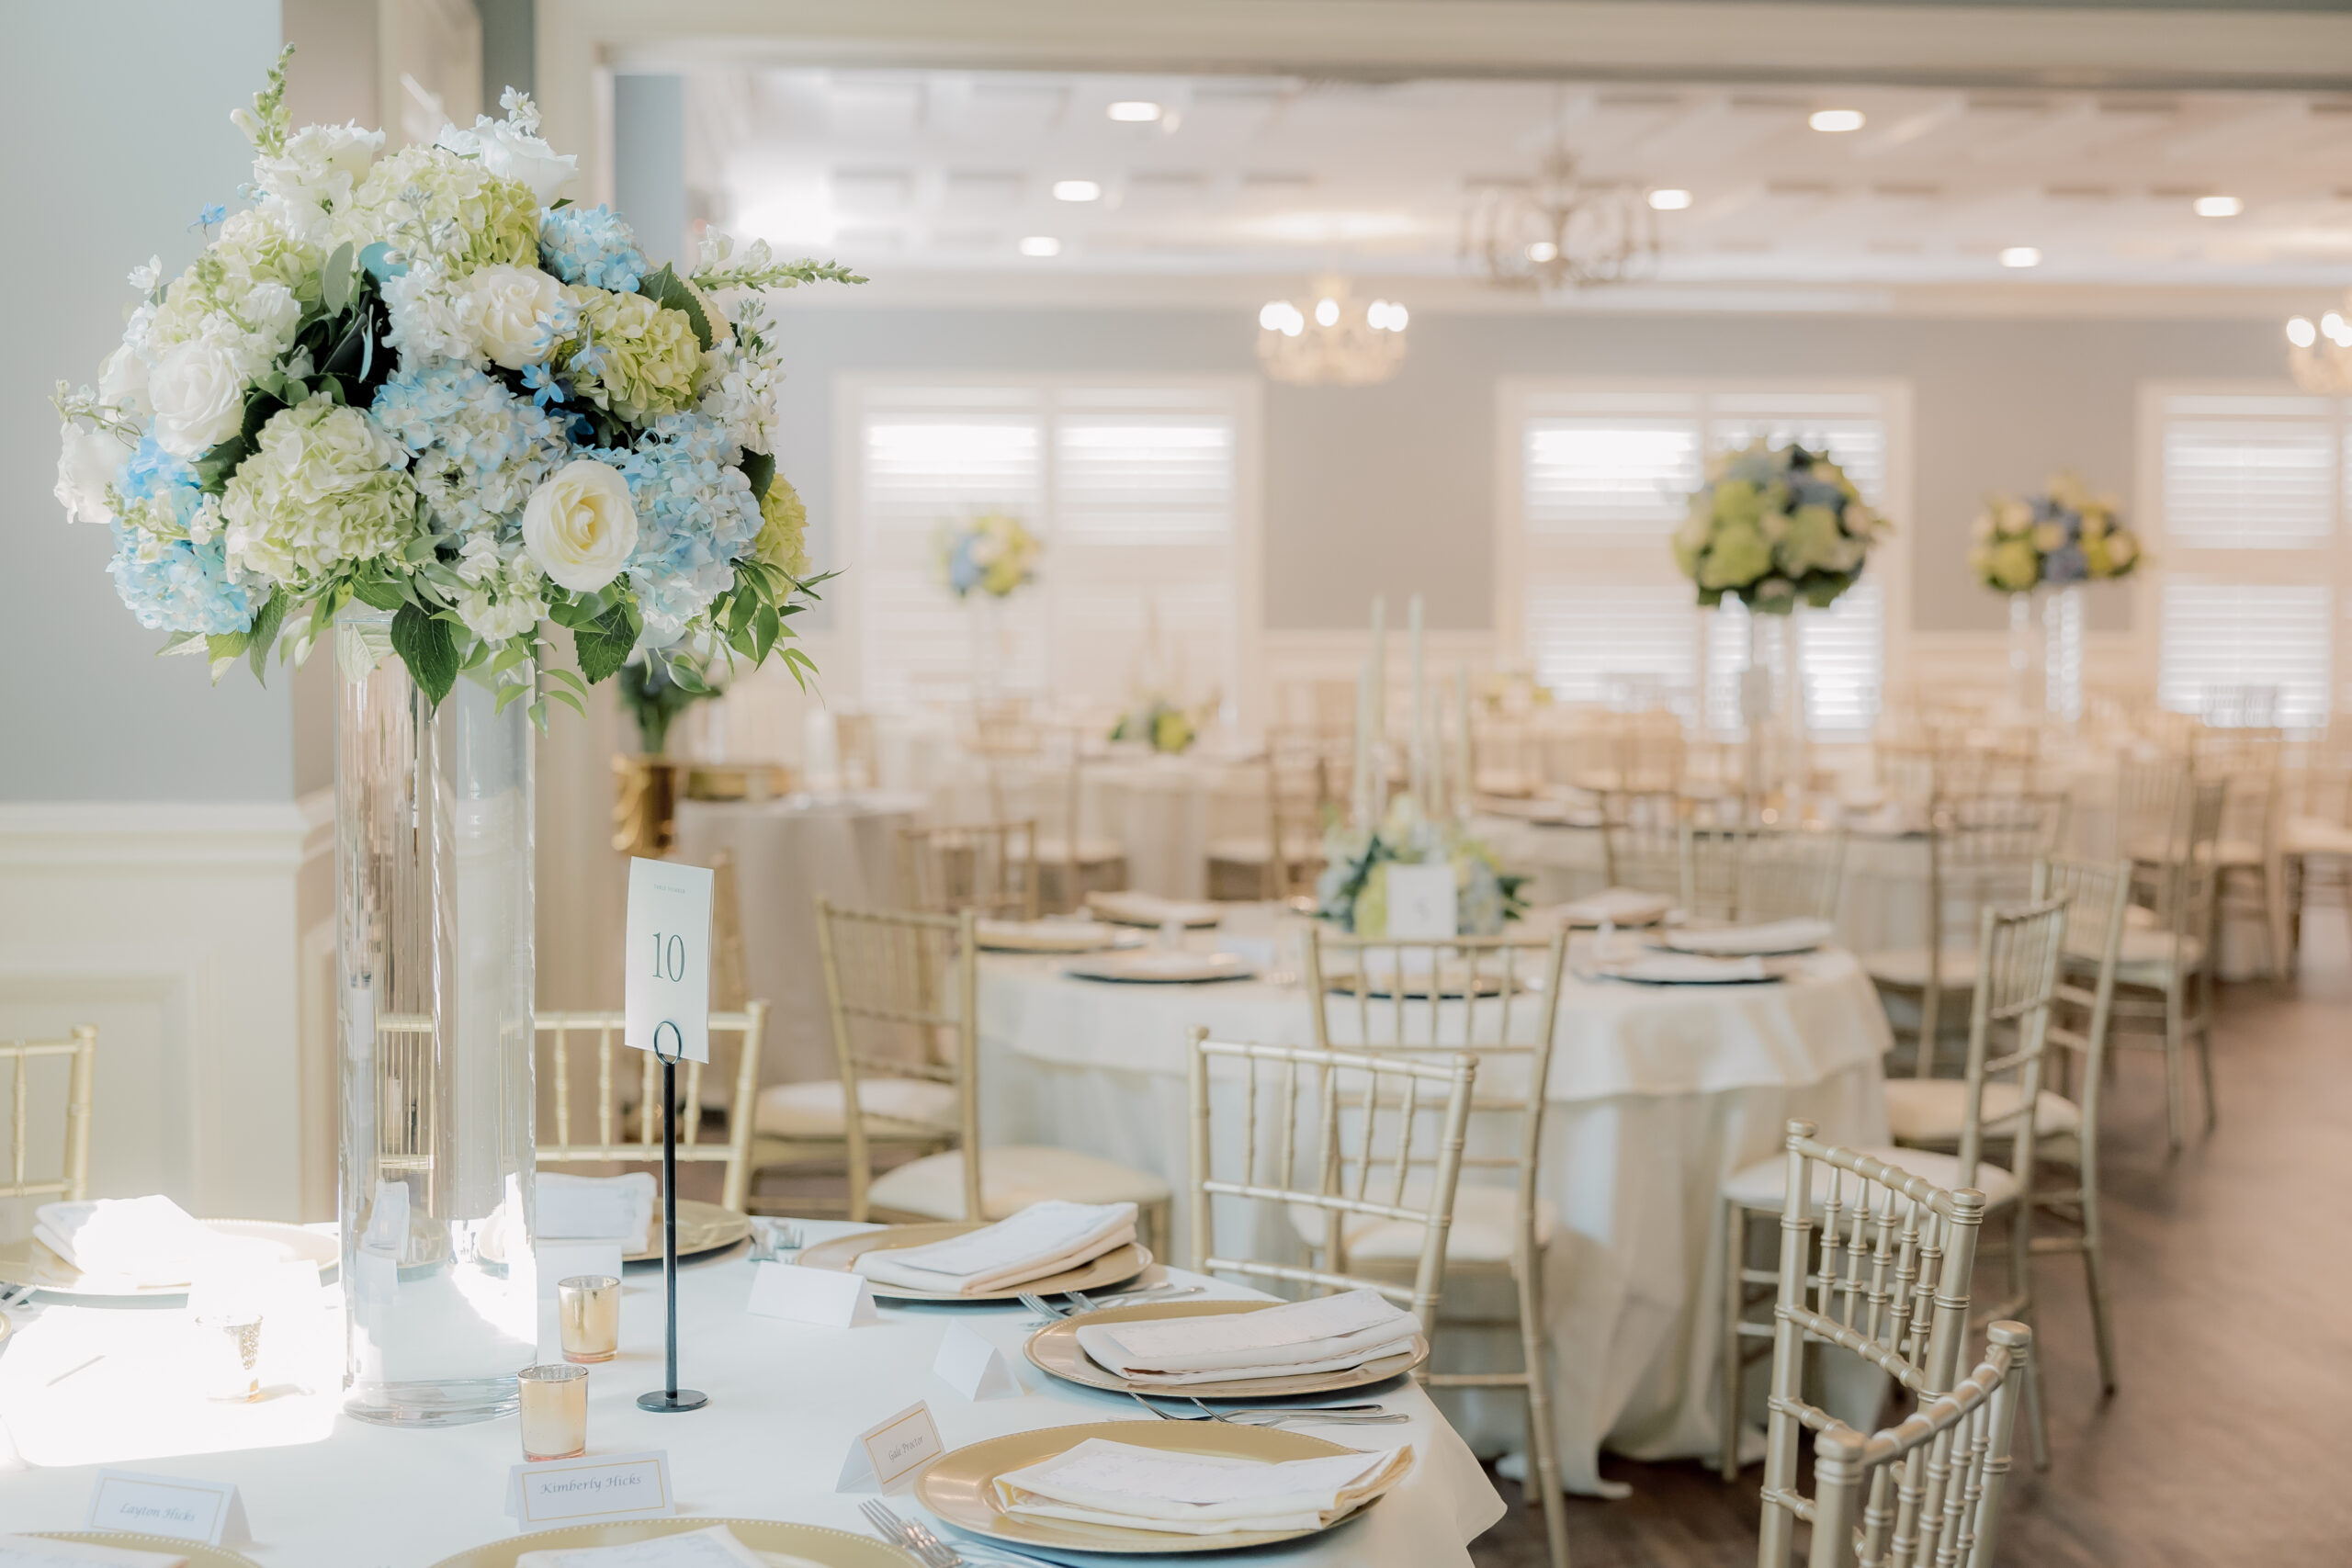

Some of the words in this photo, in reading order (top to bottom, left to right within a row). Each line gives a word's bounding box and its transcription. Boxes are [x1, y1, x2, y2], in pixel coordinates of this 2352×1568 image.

[652, 931, 685, 983] 10
[540, 1477, 602, 1495] Kimberly
[605, 1472, 641, 1487] Hicks
[119, 1501, 161, 1519] Layton
[162, 1507, 196, 1522] Hicks
